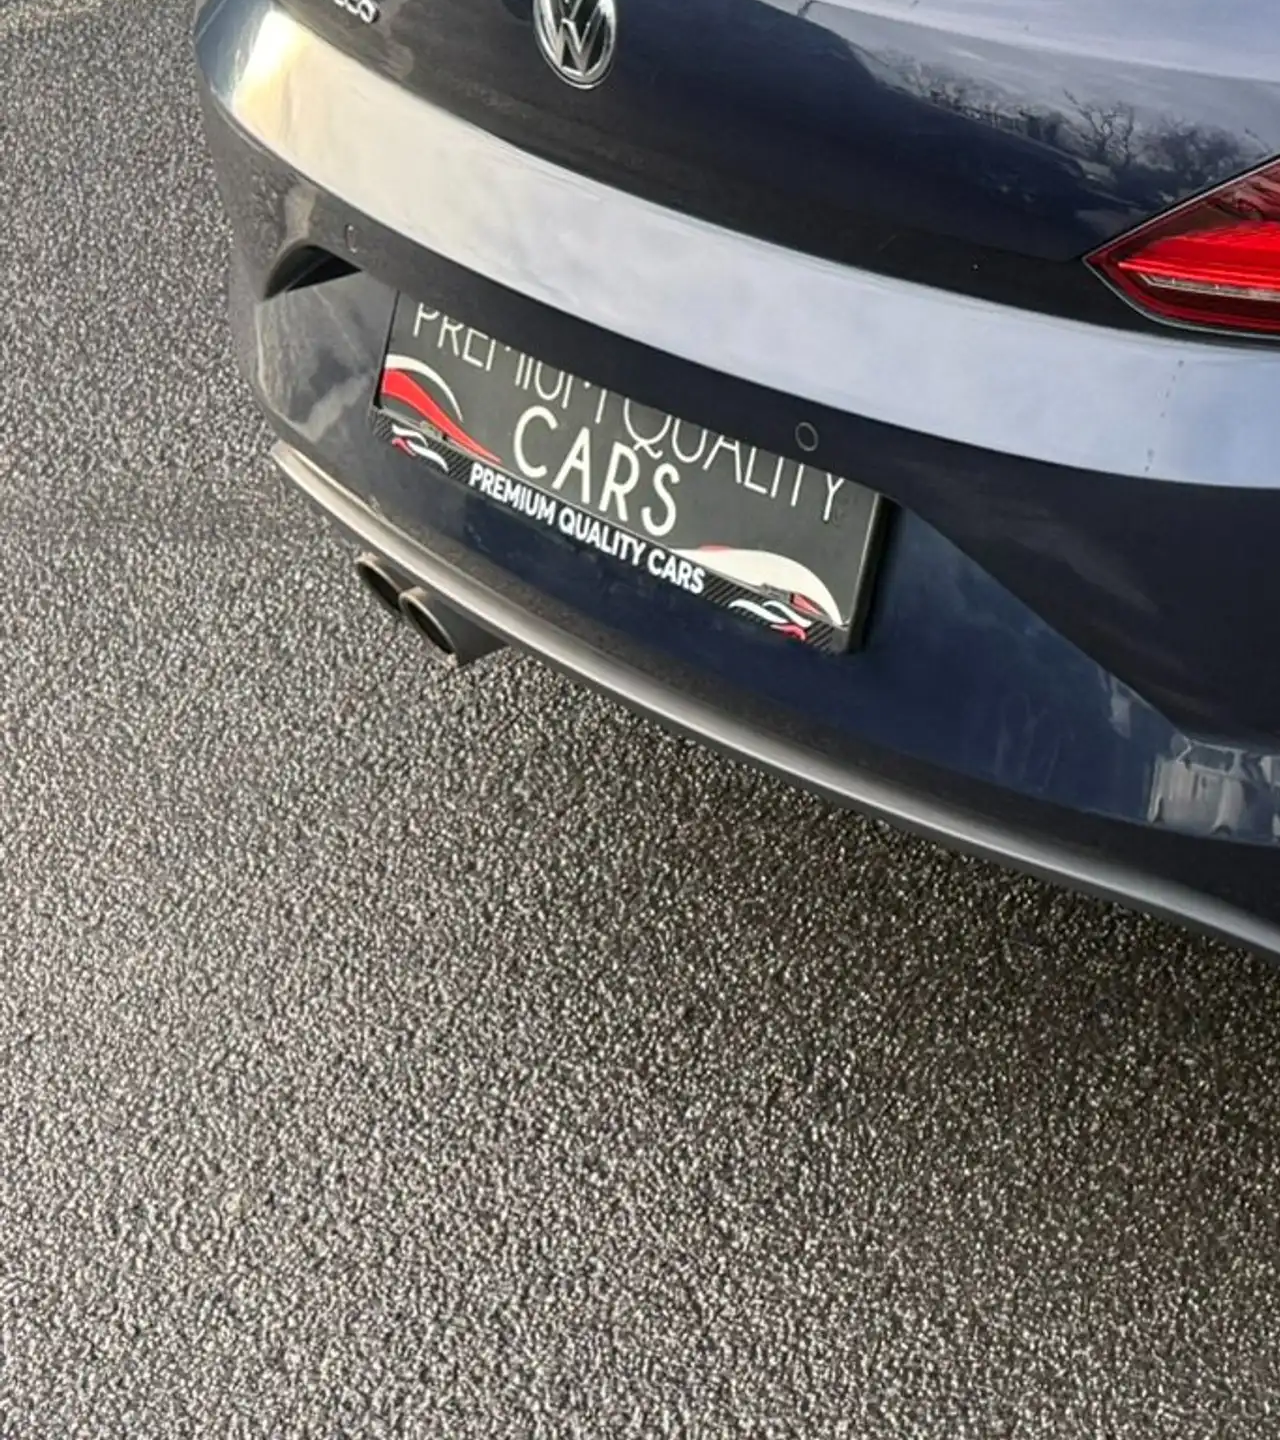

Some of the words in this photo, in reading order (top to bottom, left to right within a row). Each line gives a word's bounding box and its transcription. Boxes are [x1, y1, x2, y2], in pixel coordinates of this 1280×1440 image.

[468, 462, 556, 526] PREMIUM
[558, 507, 647, 566] QUALITY
[648, 548, 706, 594] CARS
[513, 405, 680, 537] CARS
